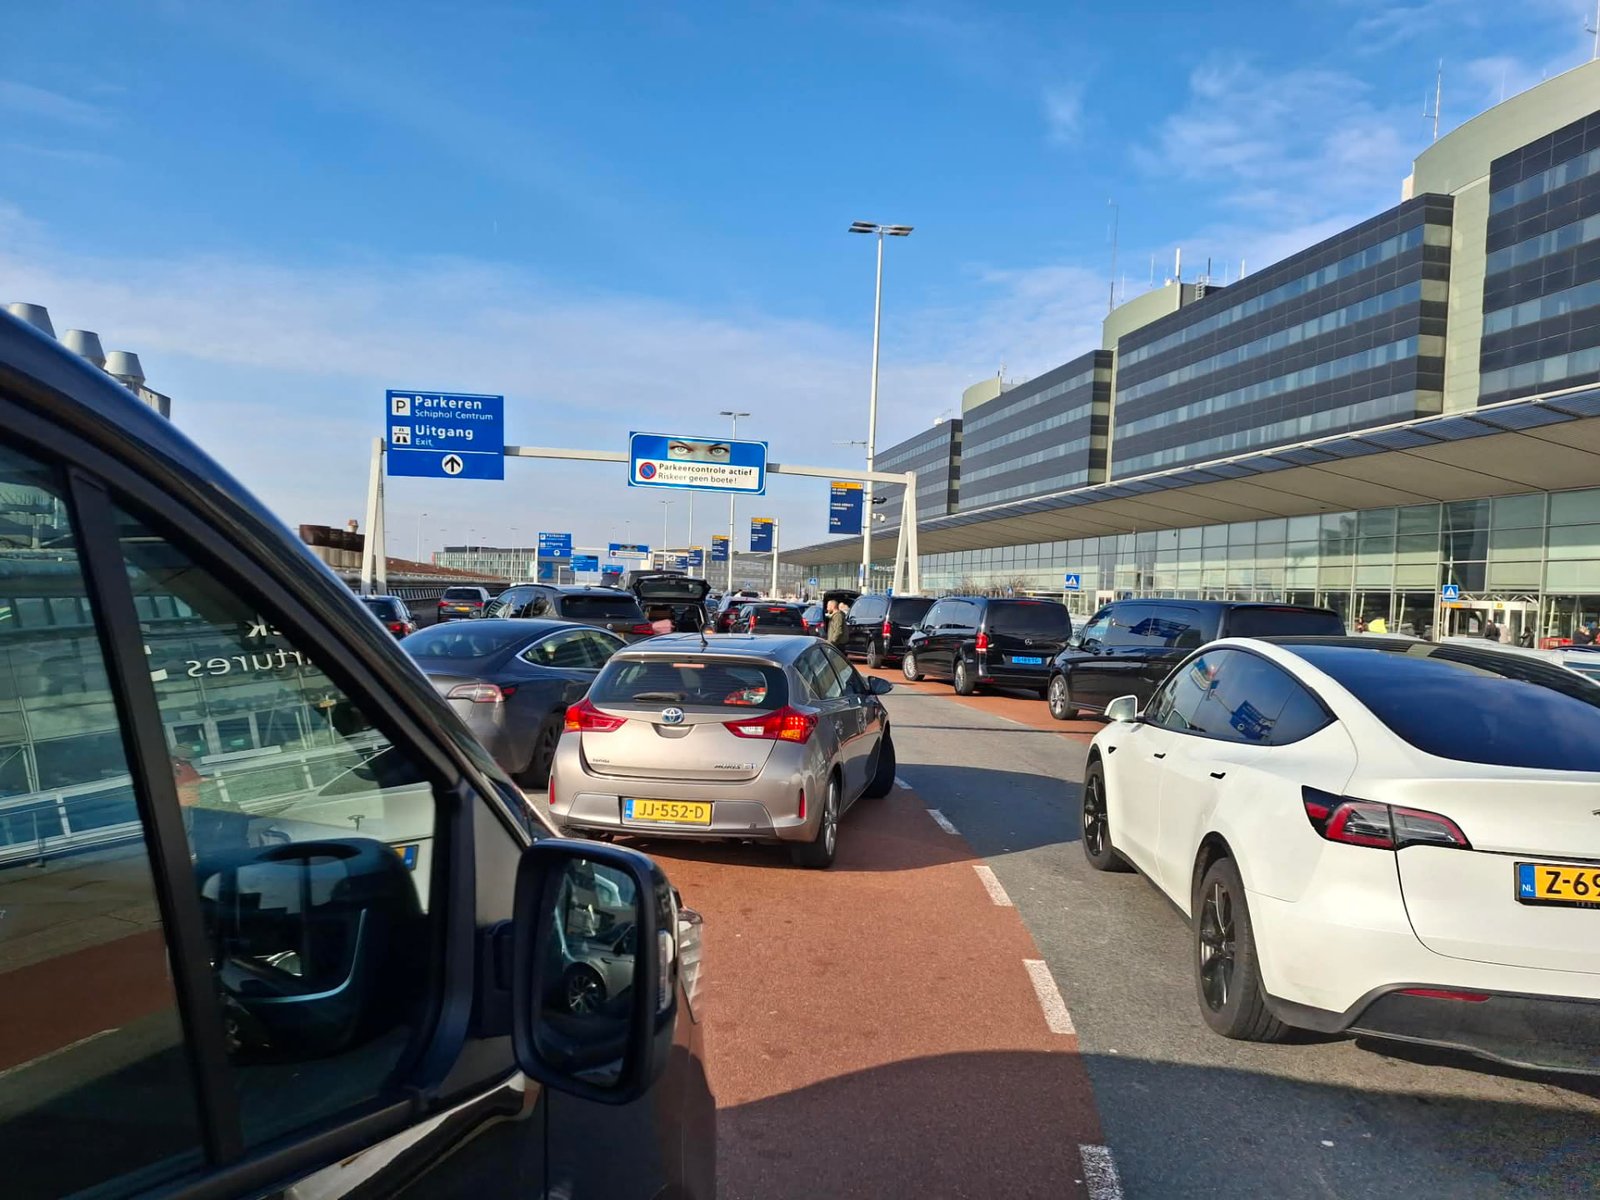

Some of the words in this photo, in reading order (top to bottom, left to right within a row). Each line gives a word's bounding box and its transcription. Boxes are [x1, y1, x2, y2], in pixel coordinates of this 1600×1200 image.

[414, 396, 482, 410] Parkeren
[415, 409, 453, 419] Schiphol
[455, 411, 493, 421] Centrum
[415, 424, 474, 440] Uitgang
[415, 438, 433, 447] Exit
[659, 463, 726, 475] Parkeercontrole
[728, 468, 752, 476] actief
[658, 472, 686, 481] Riskeer
[689, 475, 709, 483] geen
[710, 475, 737, 485] boete!
[639, 802, 704, 819] JJ-552-D
[1522, 884, 1534, 892] NL
